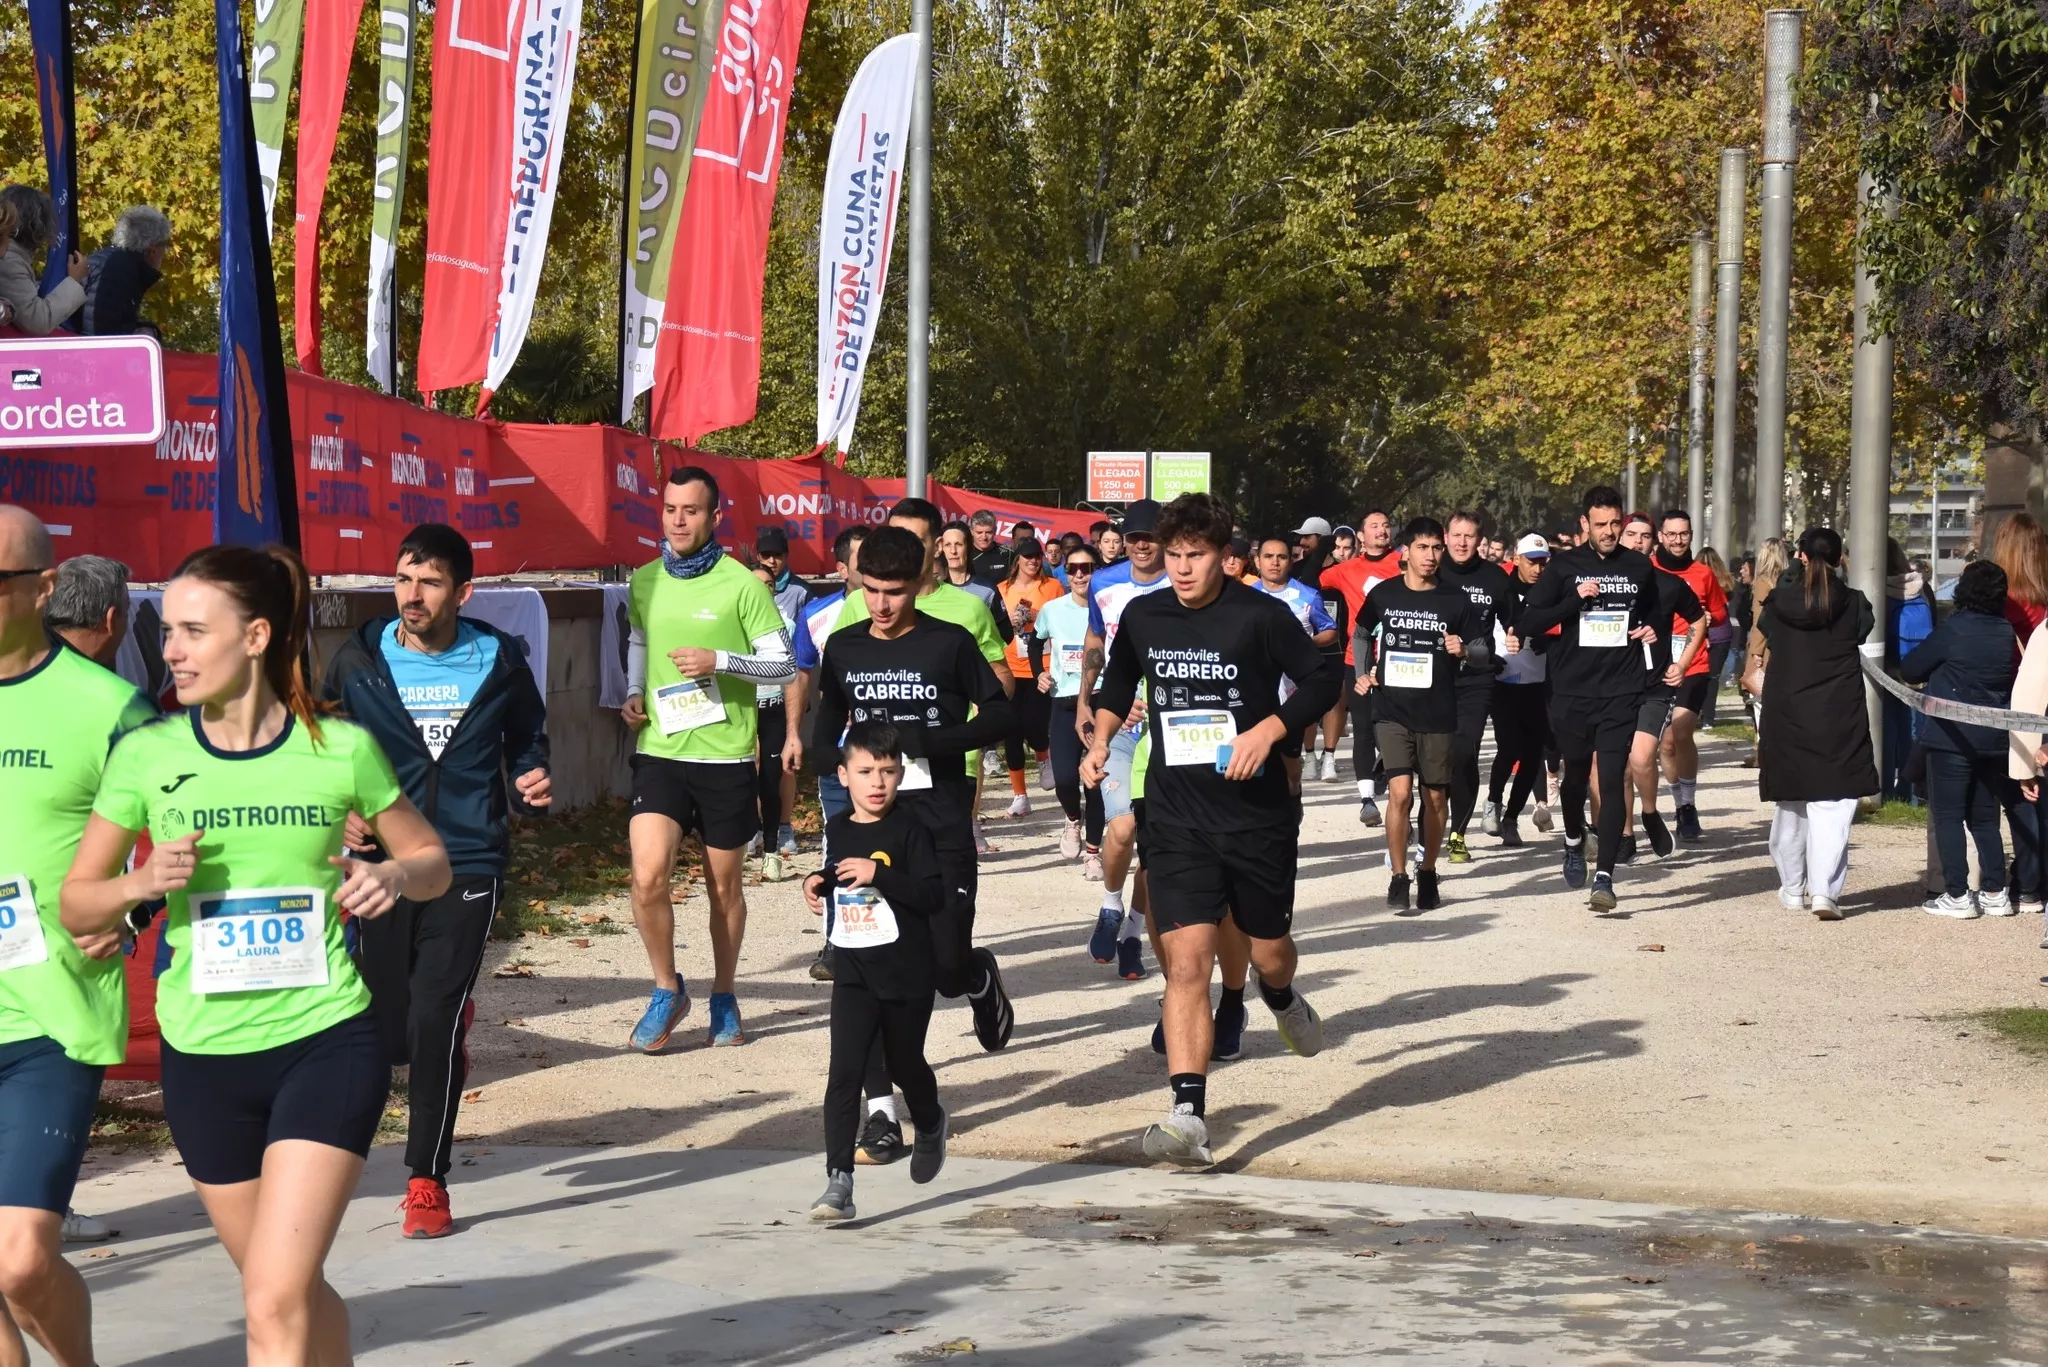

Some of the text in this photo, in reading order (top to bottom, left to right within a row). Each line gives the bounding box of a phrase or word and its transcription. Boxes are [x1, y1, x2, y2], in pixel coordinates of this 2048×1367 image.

[843, 169, 867, 257] CUNA
[841, 335, 863, 373] DE
[0, 397, 126, 429] ordeta
[156, 409, 219, 462] MONZÓ
[1093, 469, 1141, 478] LLEGADA
[1157, 469, 1204, 478] LLEGADA
[1098, 481, 1135, 489] 1250 de
[1164, 481, 1196, 489] 500 de
[1099, 491, 1122, 499] 1250
[1384, 608, 1438, 620] Automóviles
[1389, 617, 1447, 632] CABRERO
[1590, 623, 1621, 632] 1010
[1148, 647, 1220, 662] Automóviles
[845, 669, 922, 683] Automóviles
[1155, 662, 1238, 680] CABRERO
[1394, 664, 1424, 674] 1014
[399, 685, 460, 702] CARRERA
[854, 683, 938, 700] CABRERO
[668, 691, 710, 711] 1043
[1178, 728, 1225, 742] 1016
[0, 749, 53, 769] MEL
[193, 805, 332, 831] DISTROMEL
[280, 896, 310, 909] MONZÓN
[842, 905, 876, 923] 802
[217, 917, 305, 948] 3108
[237, 946, 281, 958] LAURA
